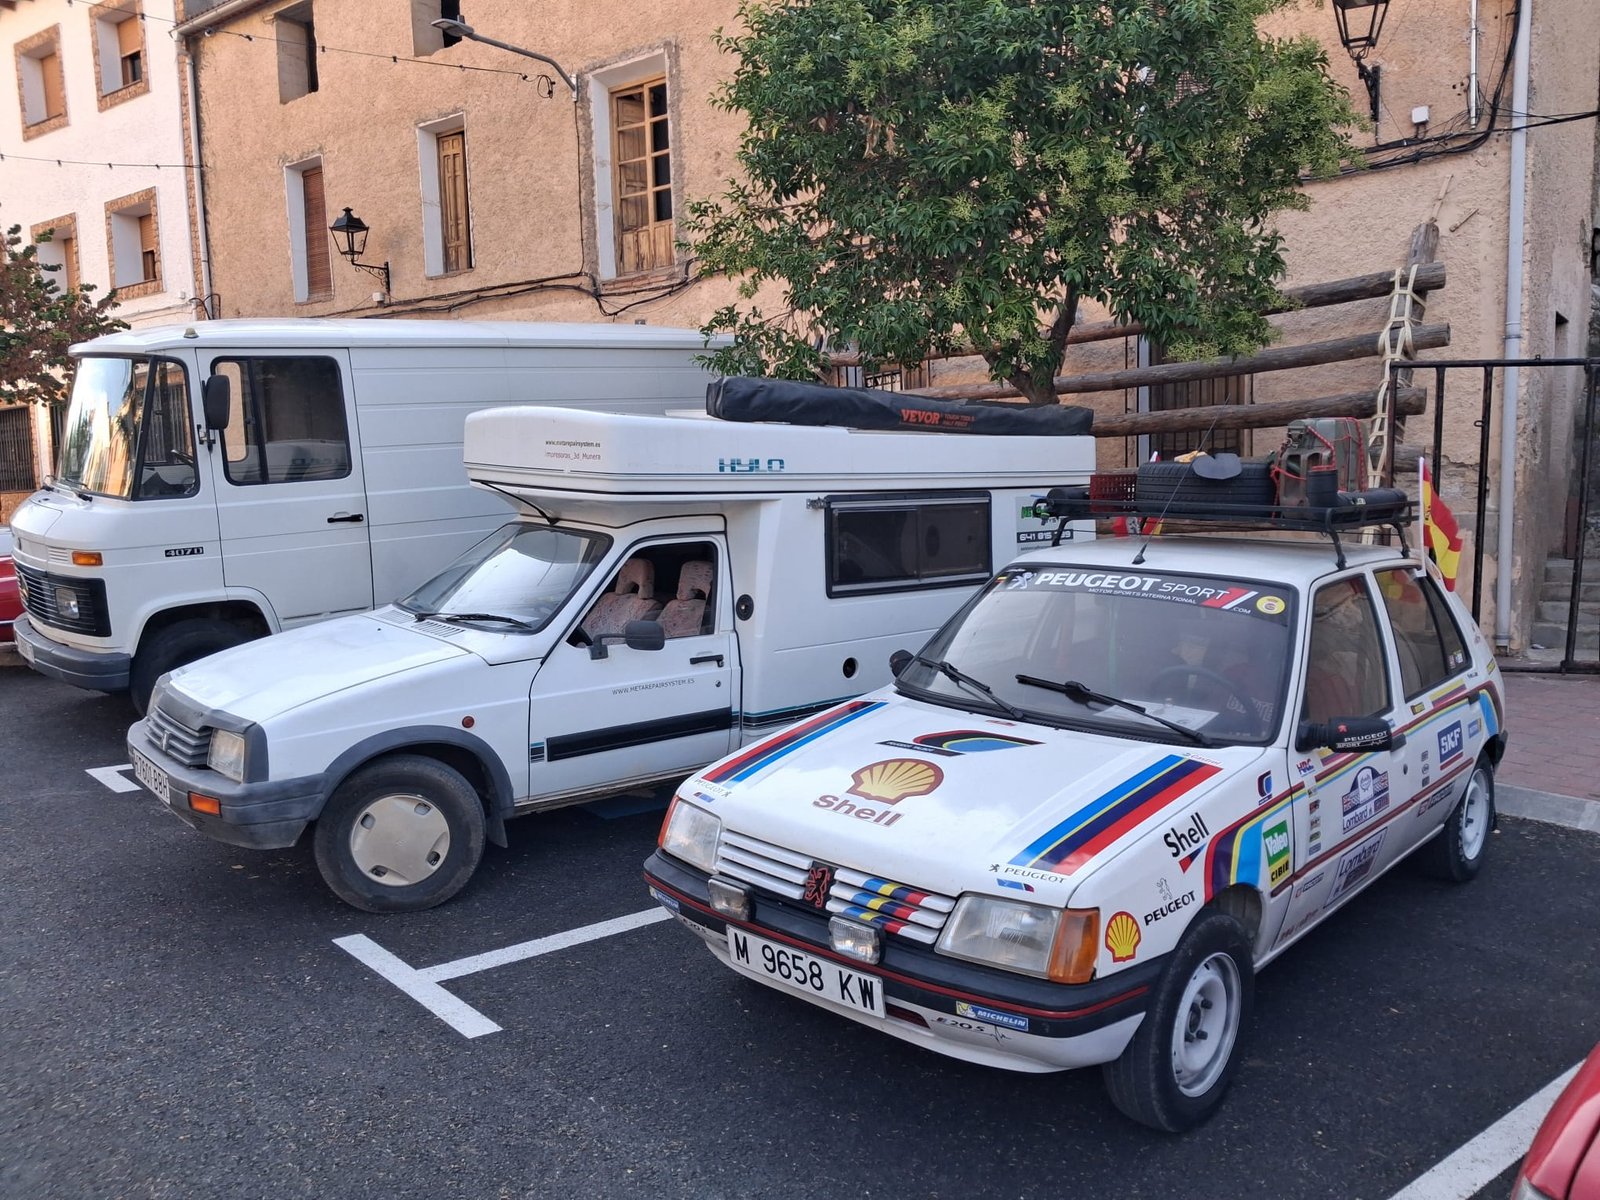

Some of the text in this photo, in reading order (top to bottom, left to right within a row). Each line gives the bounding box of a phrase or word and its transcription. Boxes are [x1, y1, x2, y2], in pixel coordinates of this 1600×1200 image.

[900, 409, 941, 424] VEVOR
[719, 458, 784, 472] HYLO
[1034, 572, 1230, 600] PEUGEOT SPORT
[1113, 589, 1141, 598] SPORTS
[1141, 593, 1197, 604] INTERNATIONAL
[612, 678, 695, 695] WWW.METAREPAIRSYSTEM.ES
[1344, 730, 1387, 742] PEUGEOT
[1441, 728, 1460, 755] SKF
[694, 779, 725, 793] PEUGEOT
[812, 795, 902, 826] Shell
[1163, 812, 1210, 857] Shell
[1265, 832, 1288, 857] Valeo
[1004, 867, 1066, 884] PEUGEOT
[1143, 890, 1197, 926] PEUGEOT
[734, 932, 876, 1011] M 9658 KW
[977, 1010, 1026, 1027] MICHELIN
